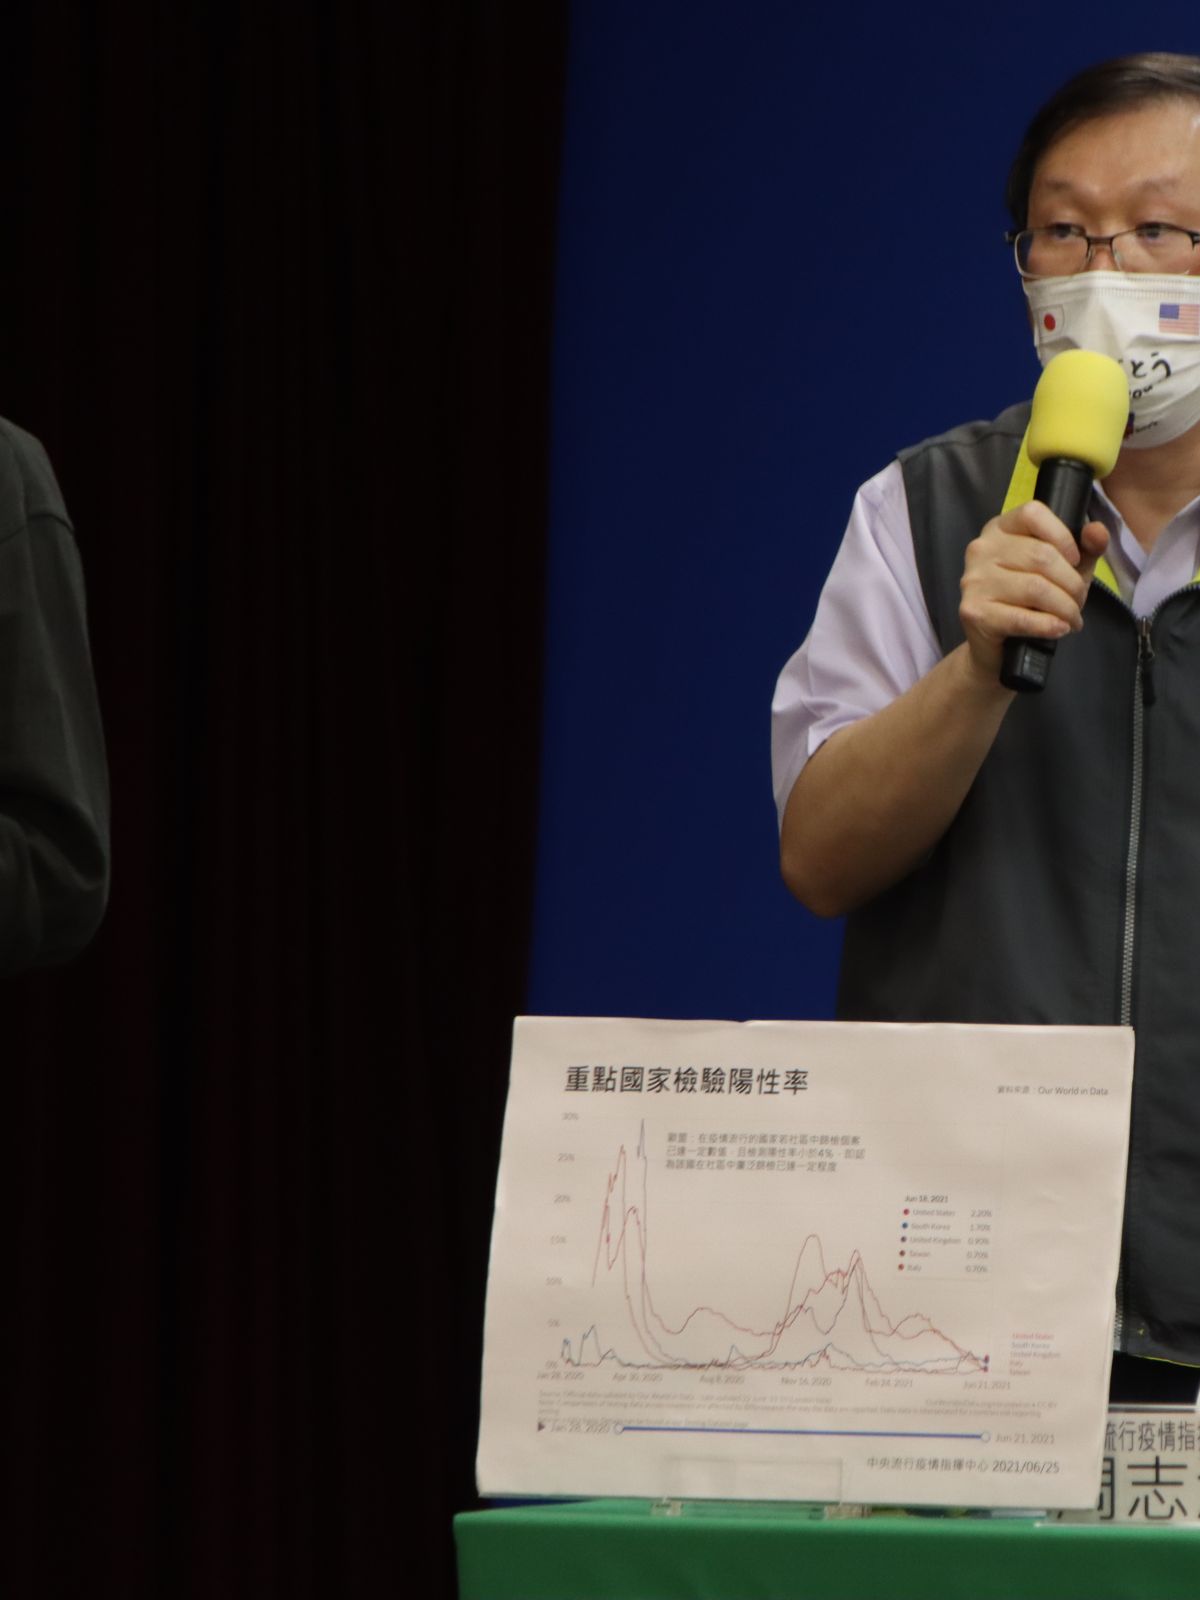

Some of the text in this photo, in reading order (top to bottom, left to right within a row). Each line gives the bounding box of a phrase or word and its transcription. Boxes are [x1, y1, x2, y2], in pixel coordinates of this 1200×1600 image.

[1117, 352, 1172, 379] とう
[565, 1065, 809, 1096] 重點國家檢驗陽性率
[1038, 1086, 1053, 1095] Our
[1055, 1086, 1080, 1096] World
[1080, 1087, 1089, 1096] in
[1090, 1086, 1109, 1097] Data
[992, 1459, 1060, 1474] 2021/06/25
